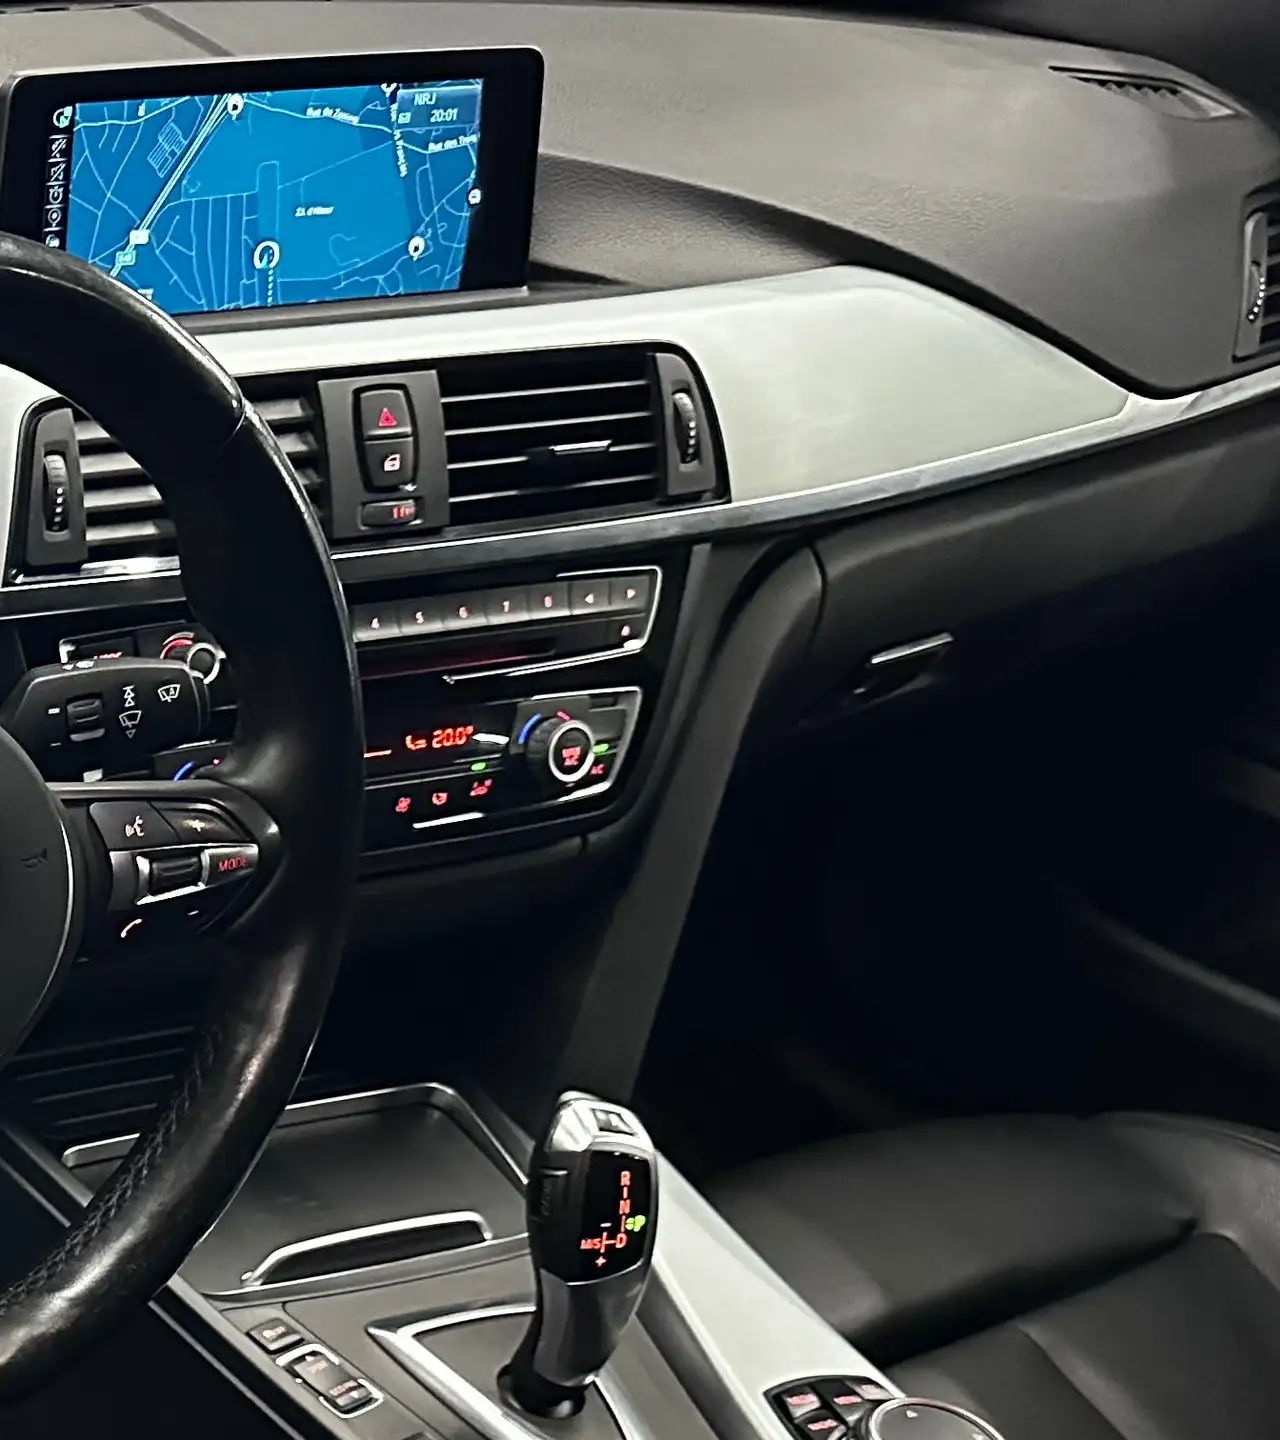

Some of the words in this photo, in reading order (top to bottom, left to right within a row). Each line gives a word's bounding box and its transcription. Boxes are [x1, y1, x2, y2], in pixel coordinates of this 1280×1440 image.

[414, 92, 437, 106] NRJ
[430, 108, 458, 123] 20:01
[620, 1170, 632, 1186] R
[619, 1199, 631, 1215] N
[615, 1232, 628, 1249] D
